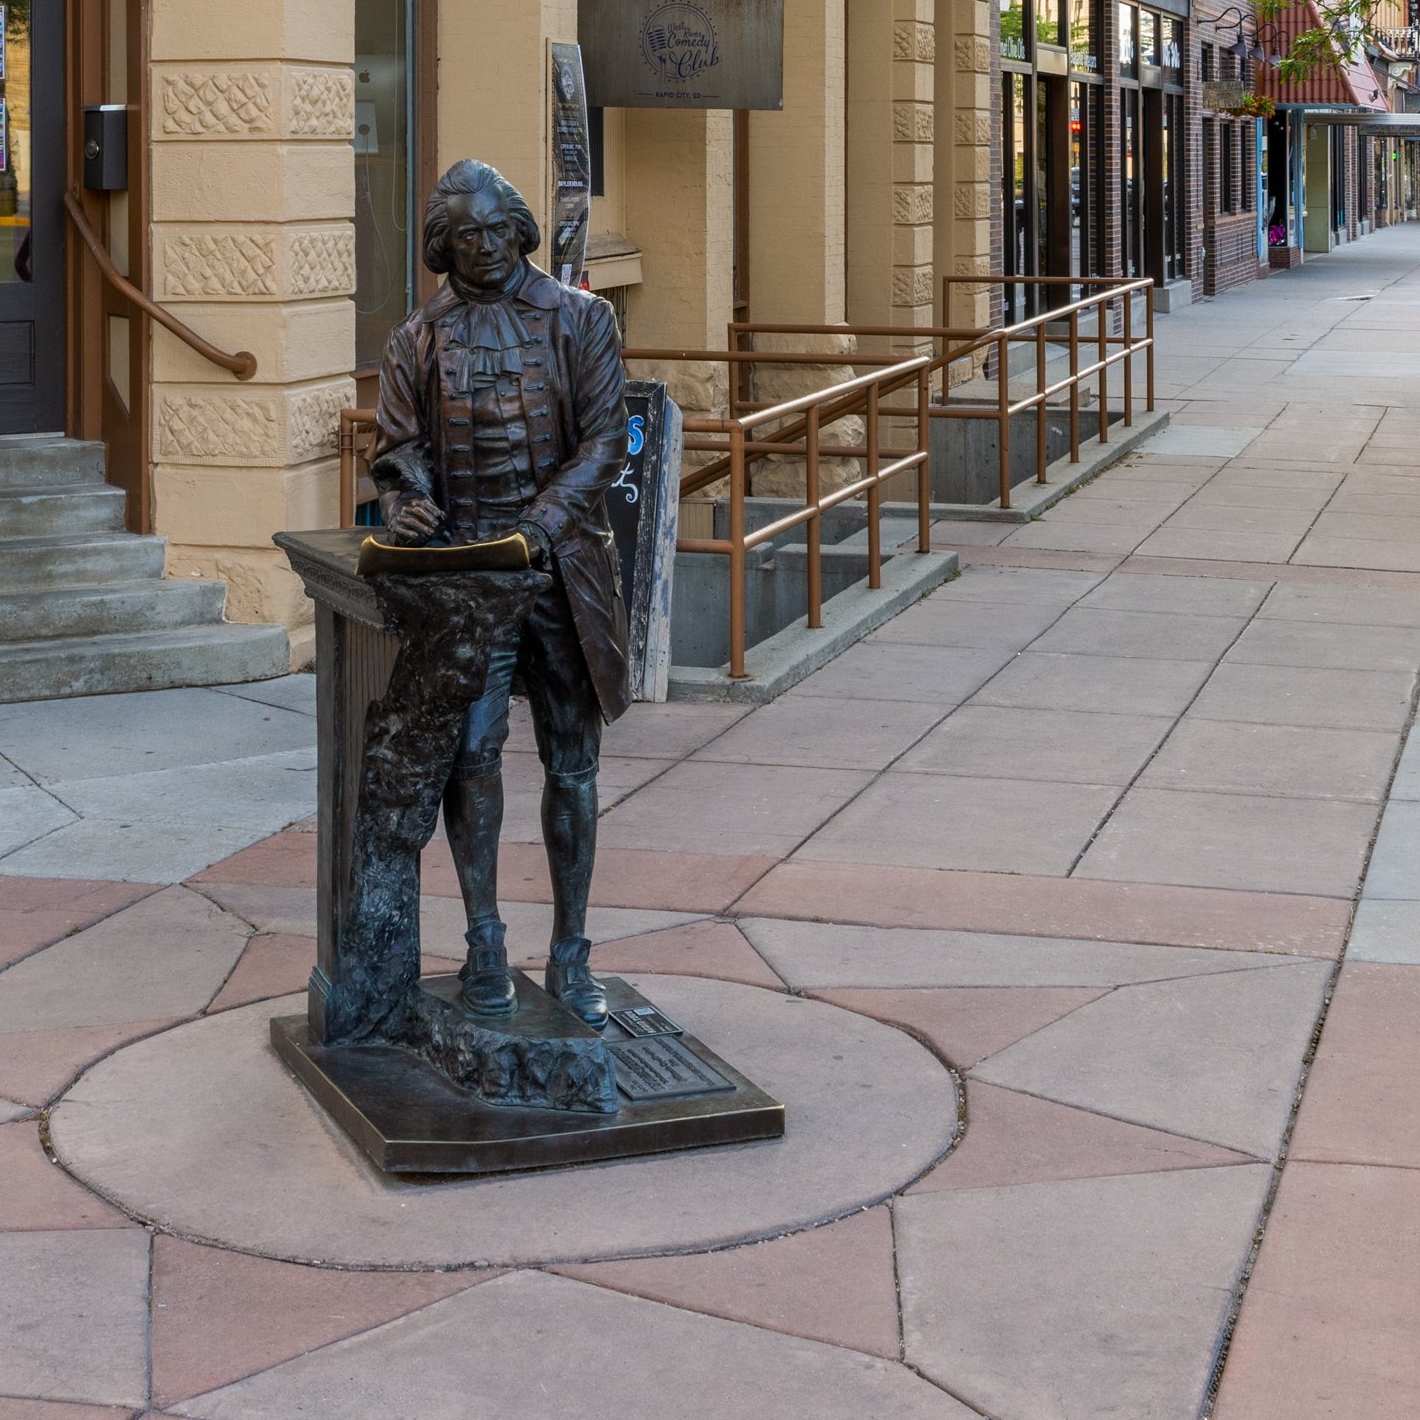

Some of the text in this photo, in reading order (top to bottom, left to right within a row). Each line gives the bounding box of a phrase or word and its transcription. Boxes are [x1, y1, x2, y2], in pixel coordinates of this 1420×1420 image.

[668, 23, 685, 33] West
[684, 27, 702, 38] River
[667, 30, 710, 52] Comedy
[669, 45, 721, 78] Club
